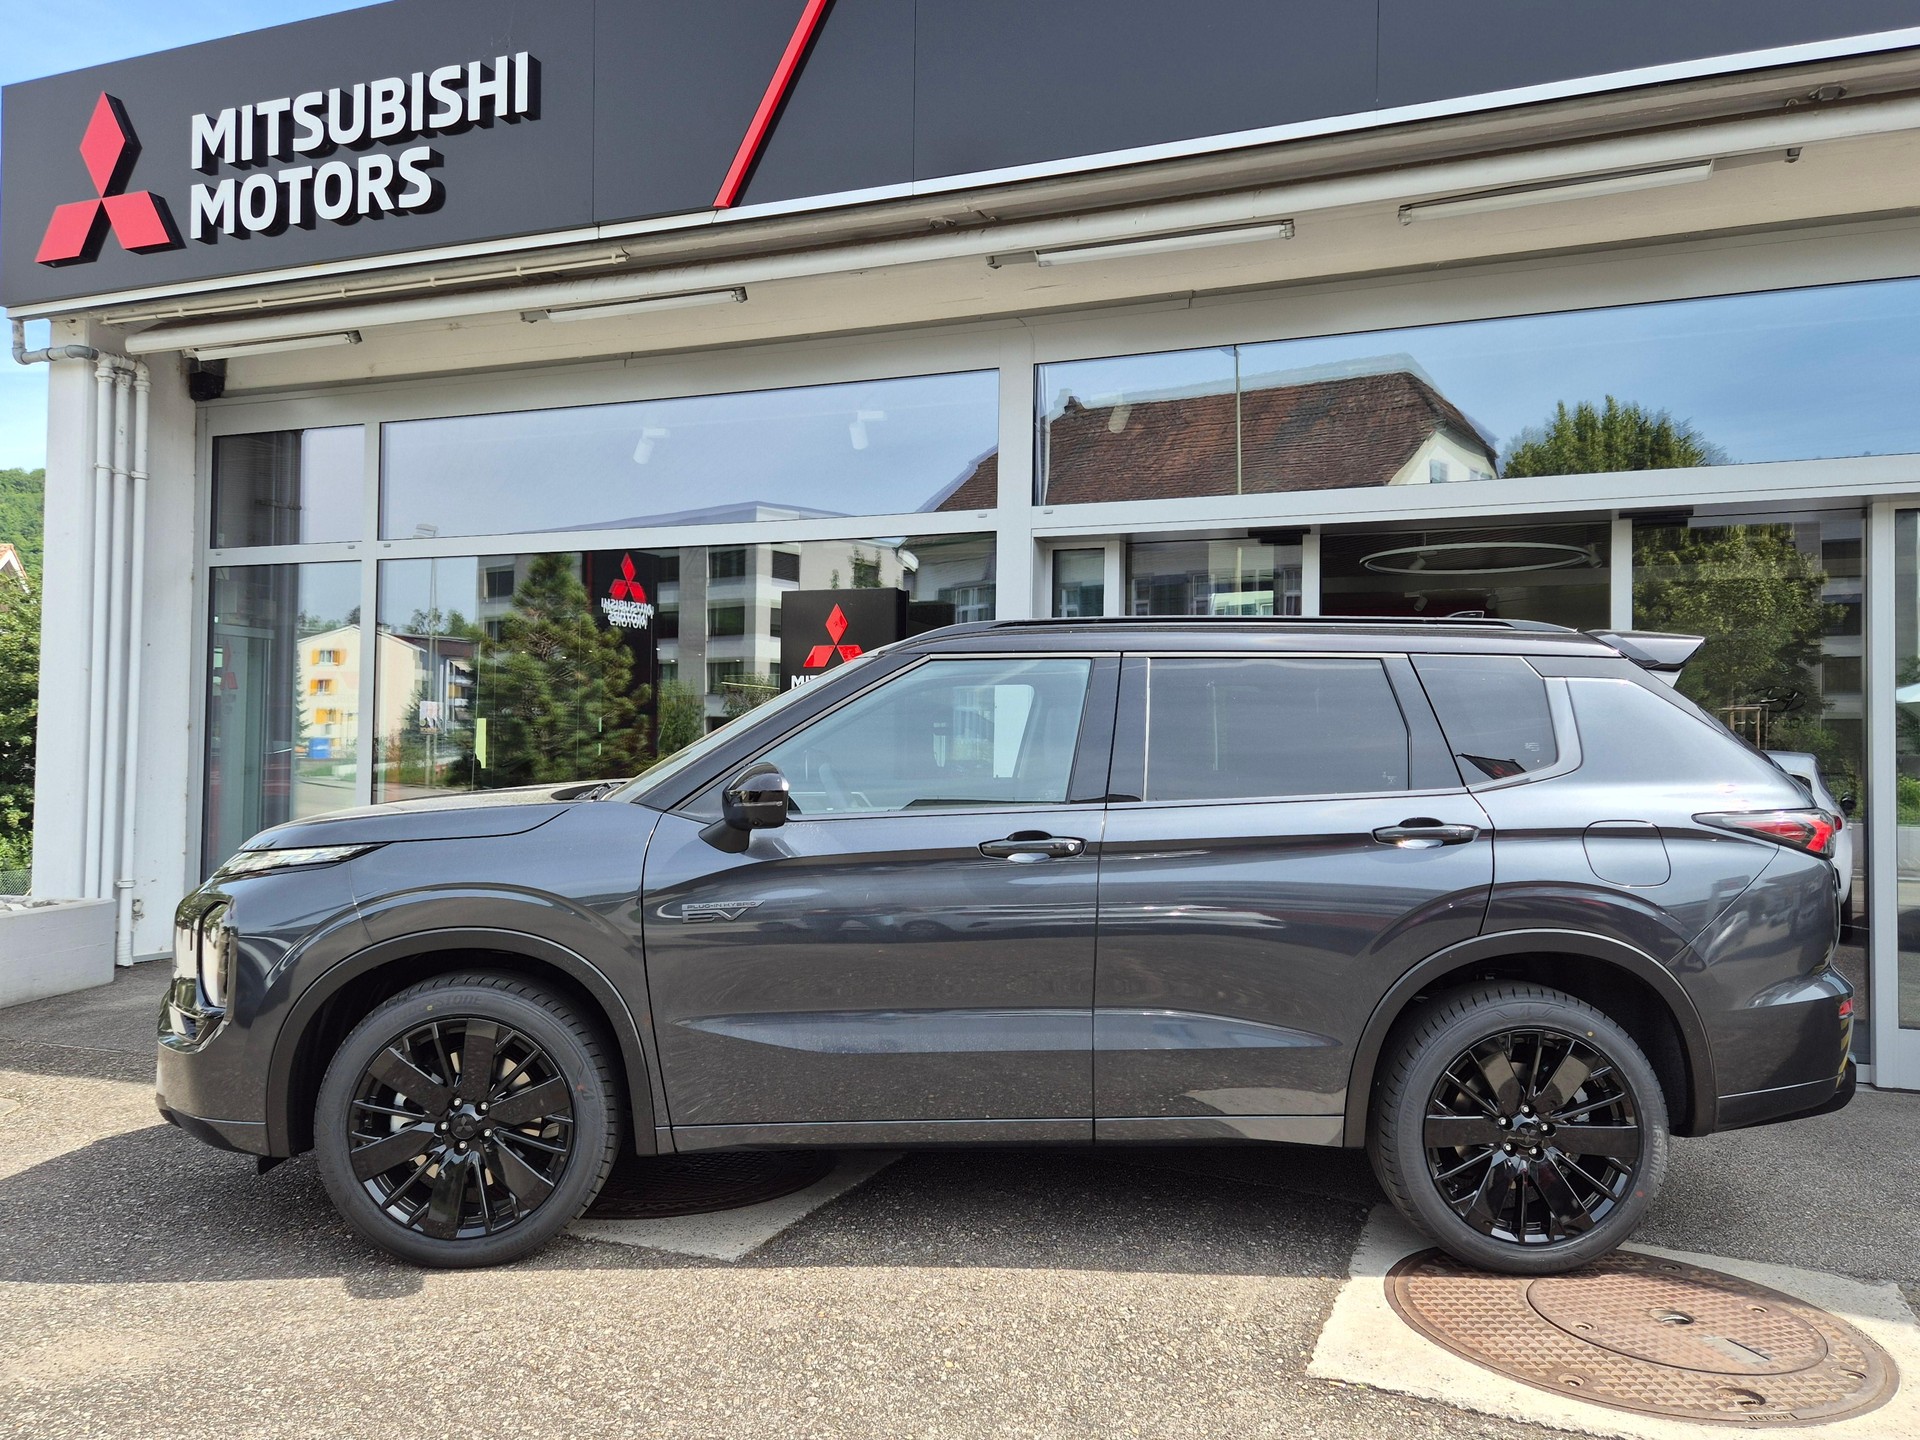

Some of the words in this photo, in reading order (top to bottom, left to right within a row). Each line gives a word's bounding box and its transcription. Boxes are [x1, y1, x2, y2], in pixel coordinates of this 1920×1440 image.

[191, 51, 529, 170] MITSUBISHI
[190, 146, 433, 240] MOTORS
[683, 908, 749, 922] EV
